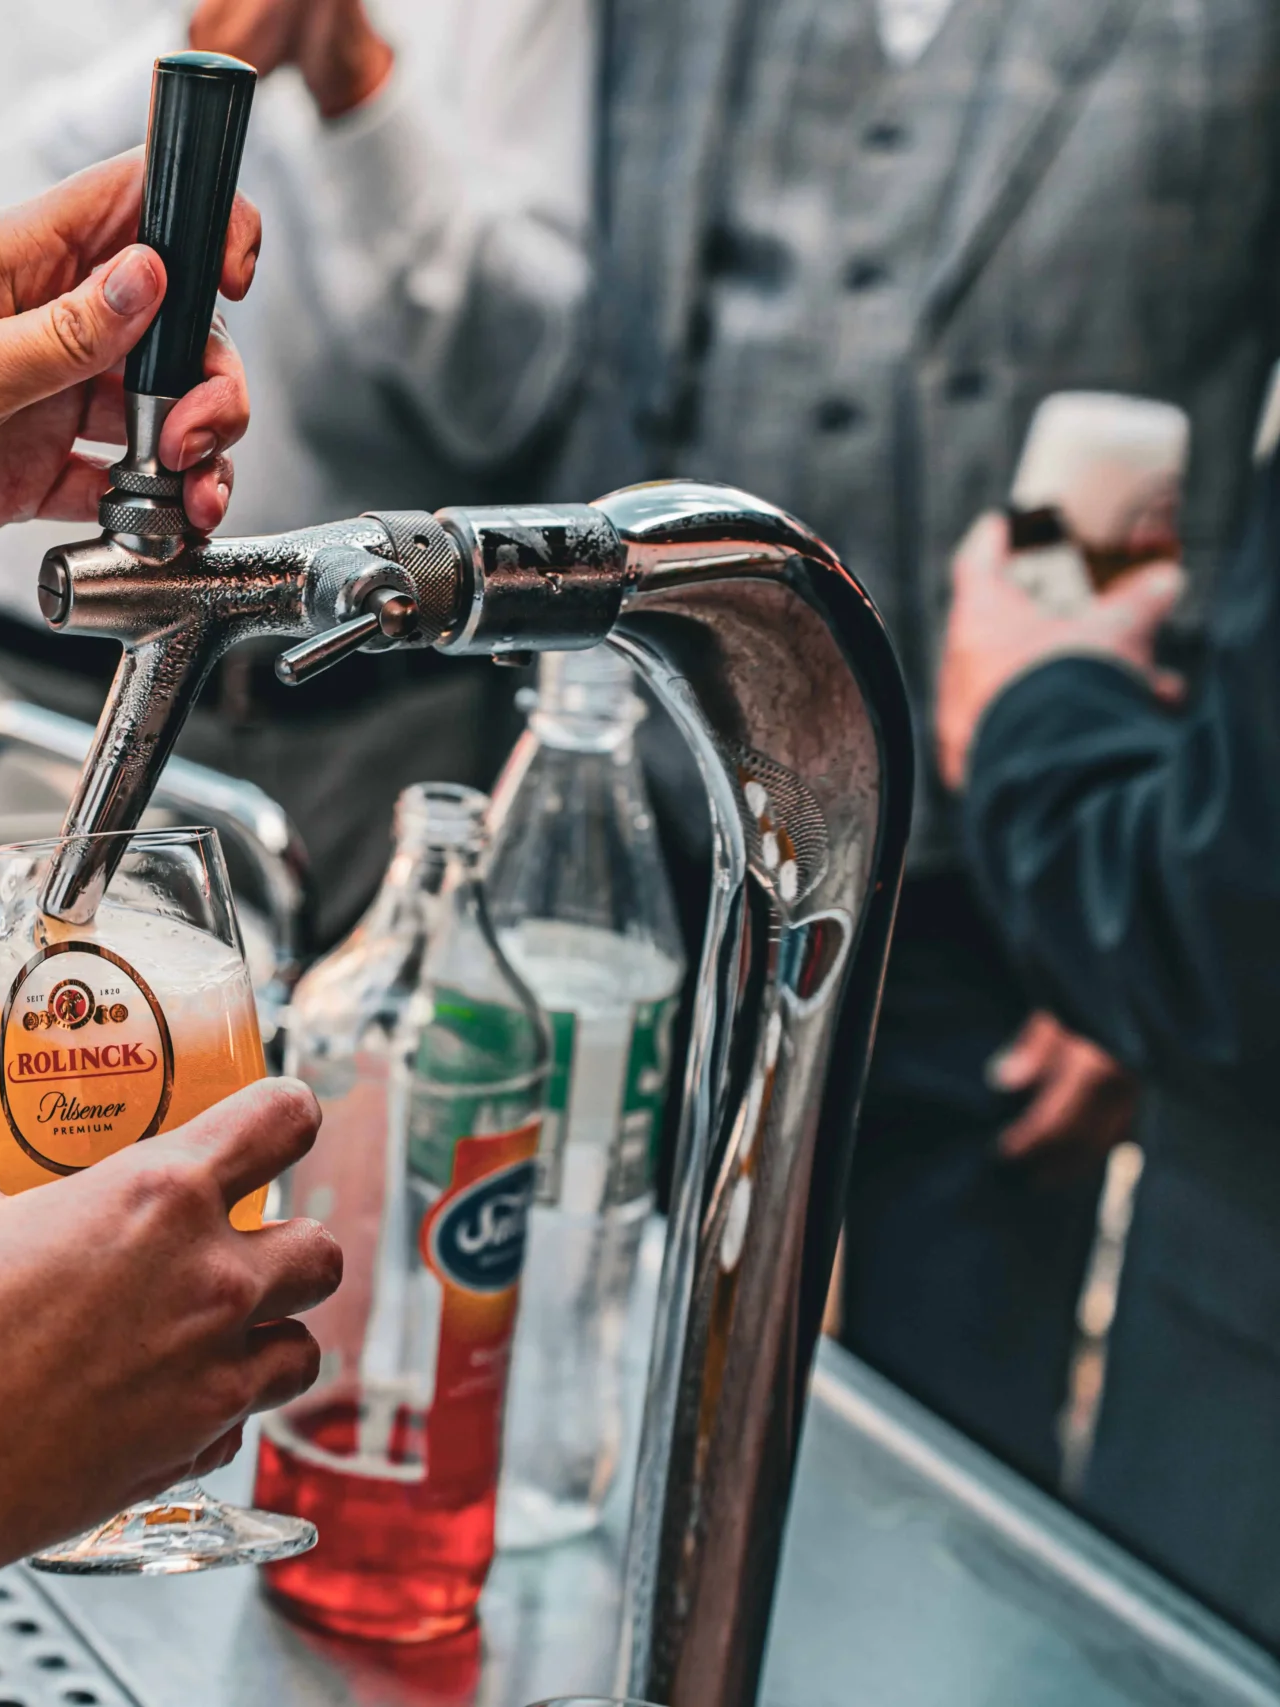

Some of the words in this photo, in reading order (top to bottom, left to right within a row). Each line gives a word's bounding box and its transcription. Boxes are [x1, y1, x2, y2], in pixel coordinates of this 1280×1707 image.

[26, 994, 45, 1003] SEIT
[100, 988, 120, 996] 1820
[16, 1042, 147, 1076] ROLINCK
[37, 1091, 126, 1123] Pilsener
[53, 1123, 113, 1136] PREMIUM
